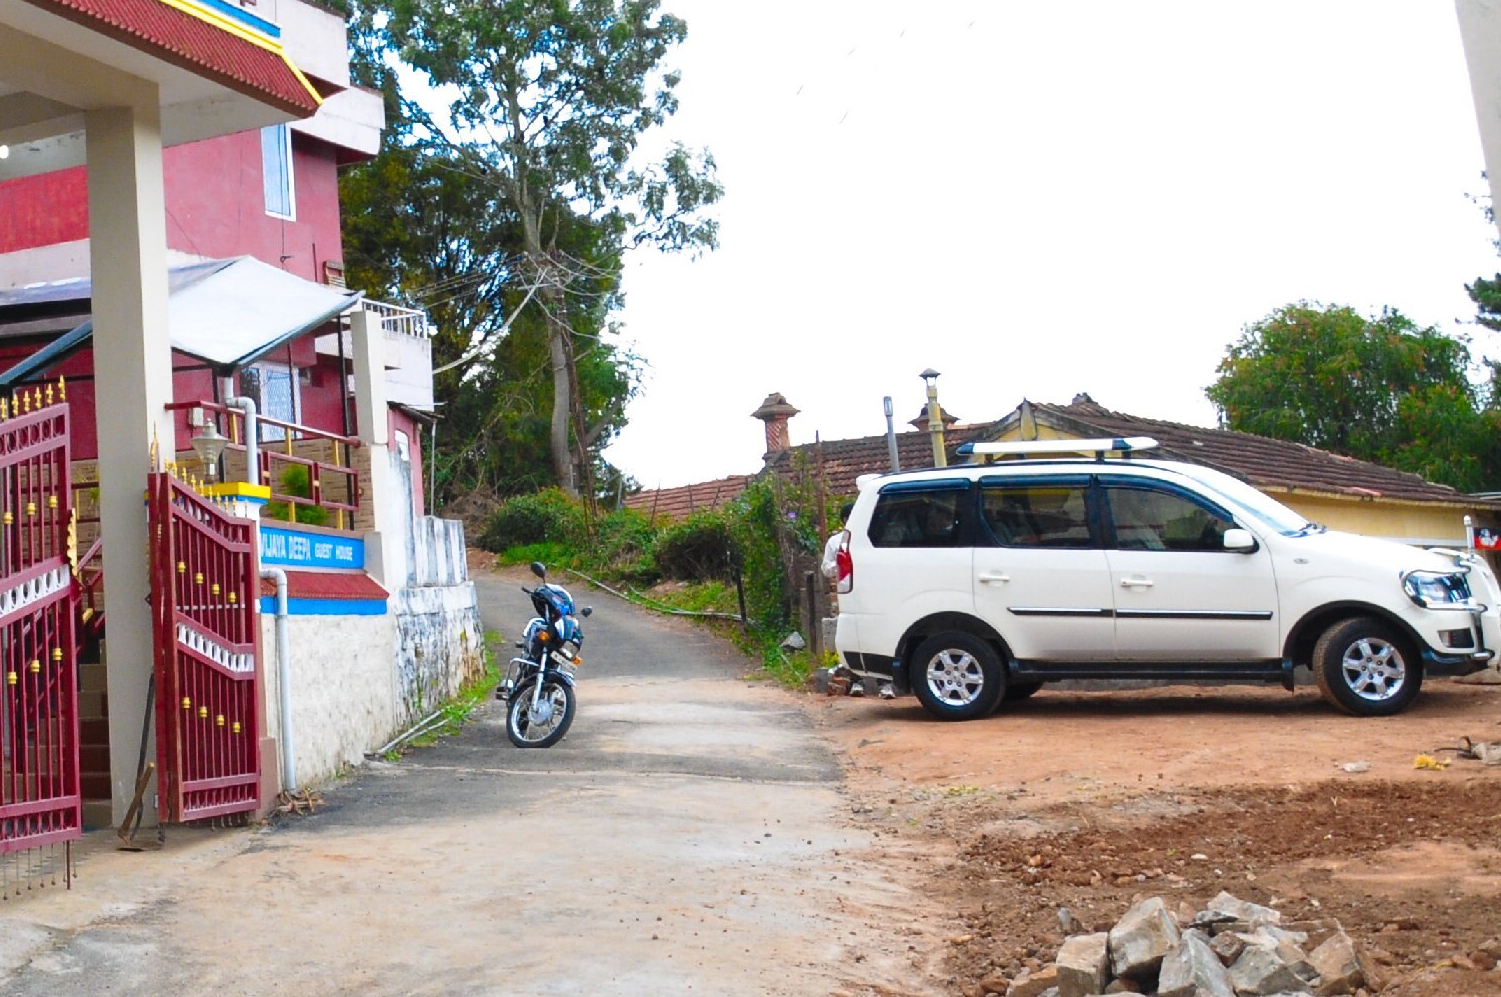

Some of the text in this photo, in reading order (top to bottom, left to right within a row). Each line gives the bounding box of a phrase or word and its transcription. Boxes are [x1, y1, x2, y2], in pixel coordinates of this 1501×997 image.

[288, 536, 311, 561] DEEPA
[314, 543, 333, 559] GUEST
[335, 545, 353, 562] HOUSE
